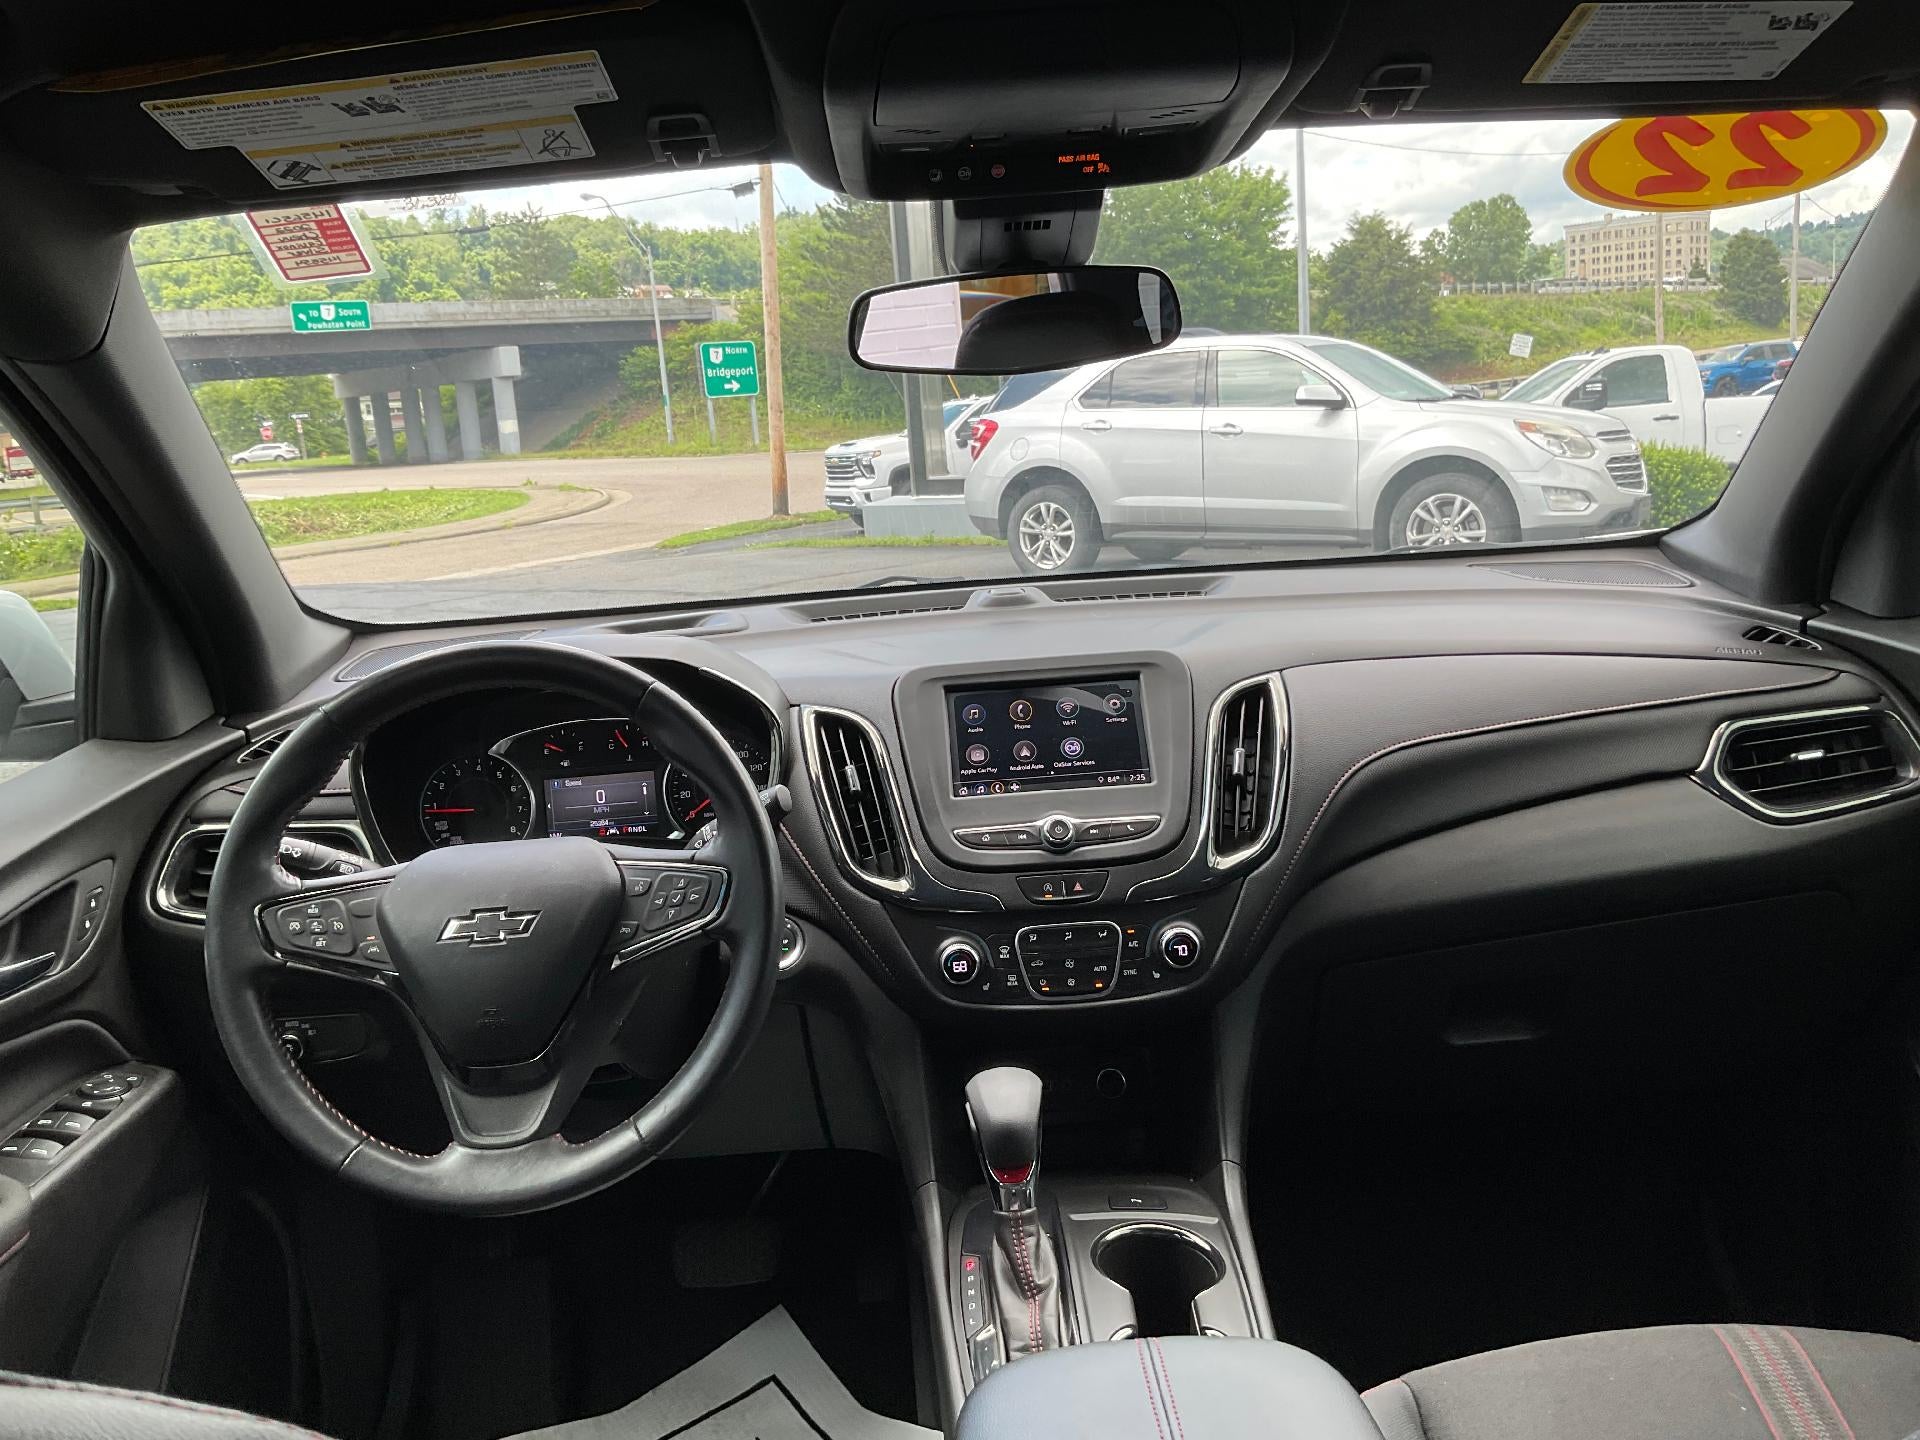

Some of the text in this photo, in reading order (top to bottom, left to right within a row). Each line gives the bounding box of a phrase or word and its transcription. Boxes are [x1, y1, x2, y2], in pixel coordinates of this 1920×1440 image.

[189, 107, 213, 115] WITH
[217, 102, 270, 111] ADVANCED
[1058, 155, 1074, 163] PASS
[308, 319, 366, 330] Powhatan Point
[707, 366, 753, 379] Bridgeport
[960, 767, 977, 775] Apple
[596, 789, 605, 804] 0
[1173, 944, 1188, 957] 70
